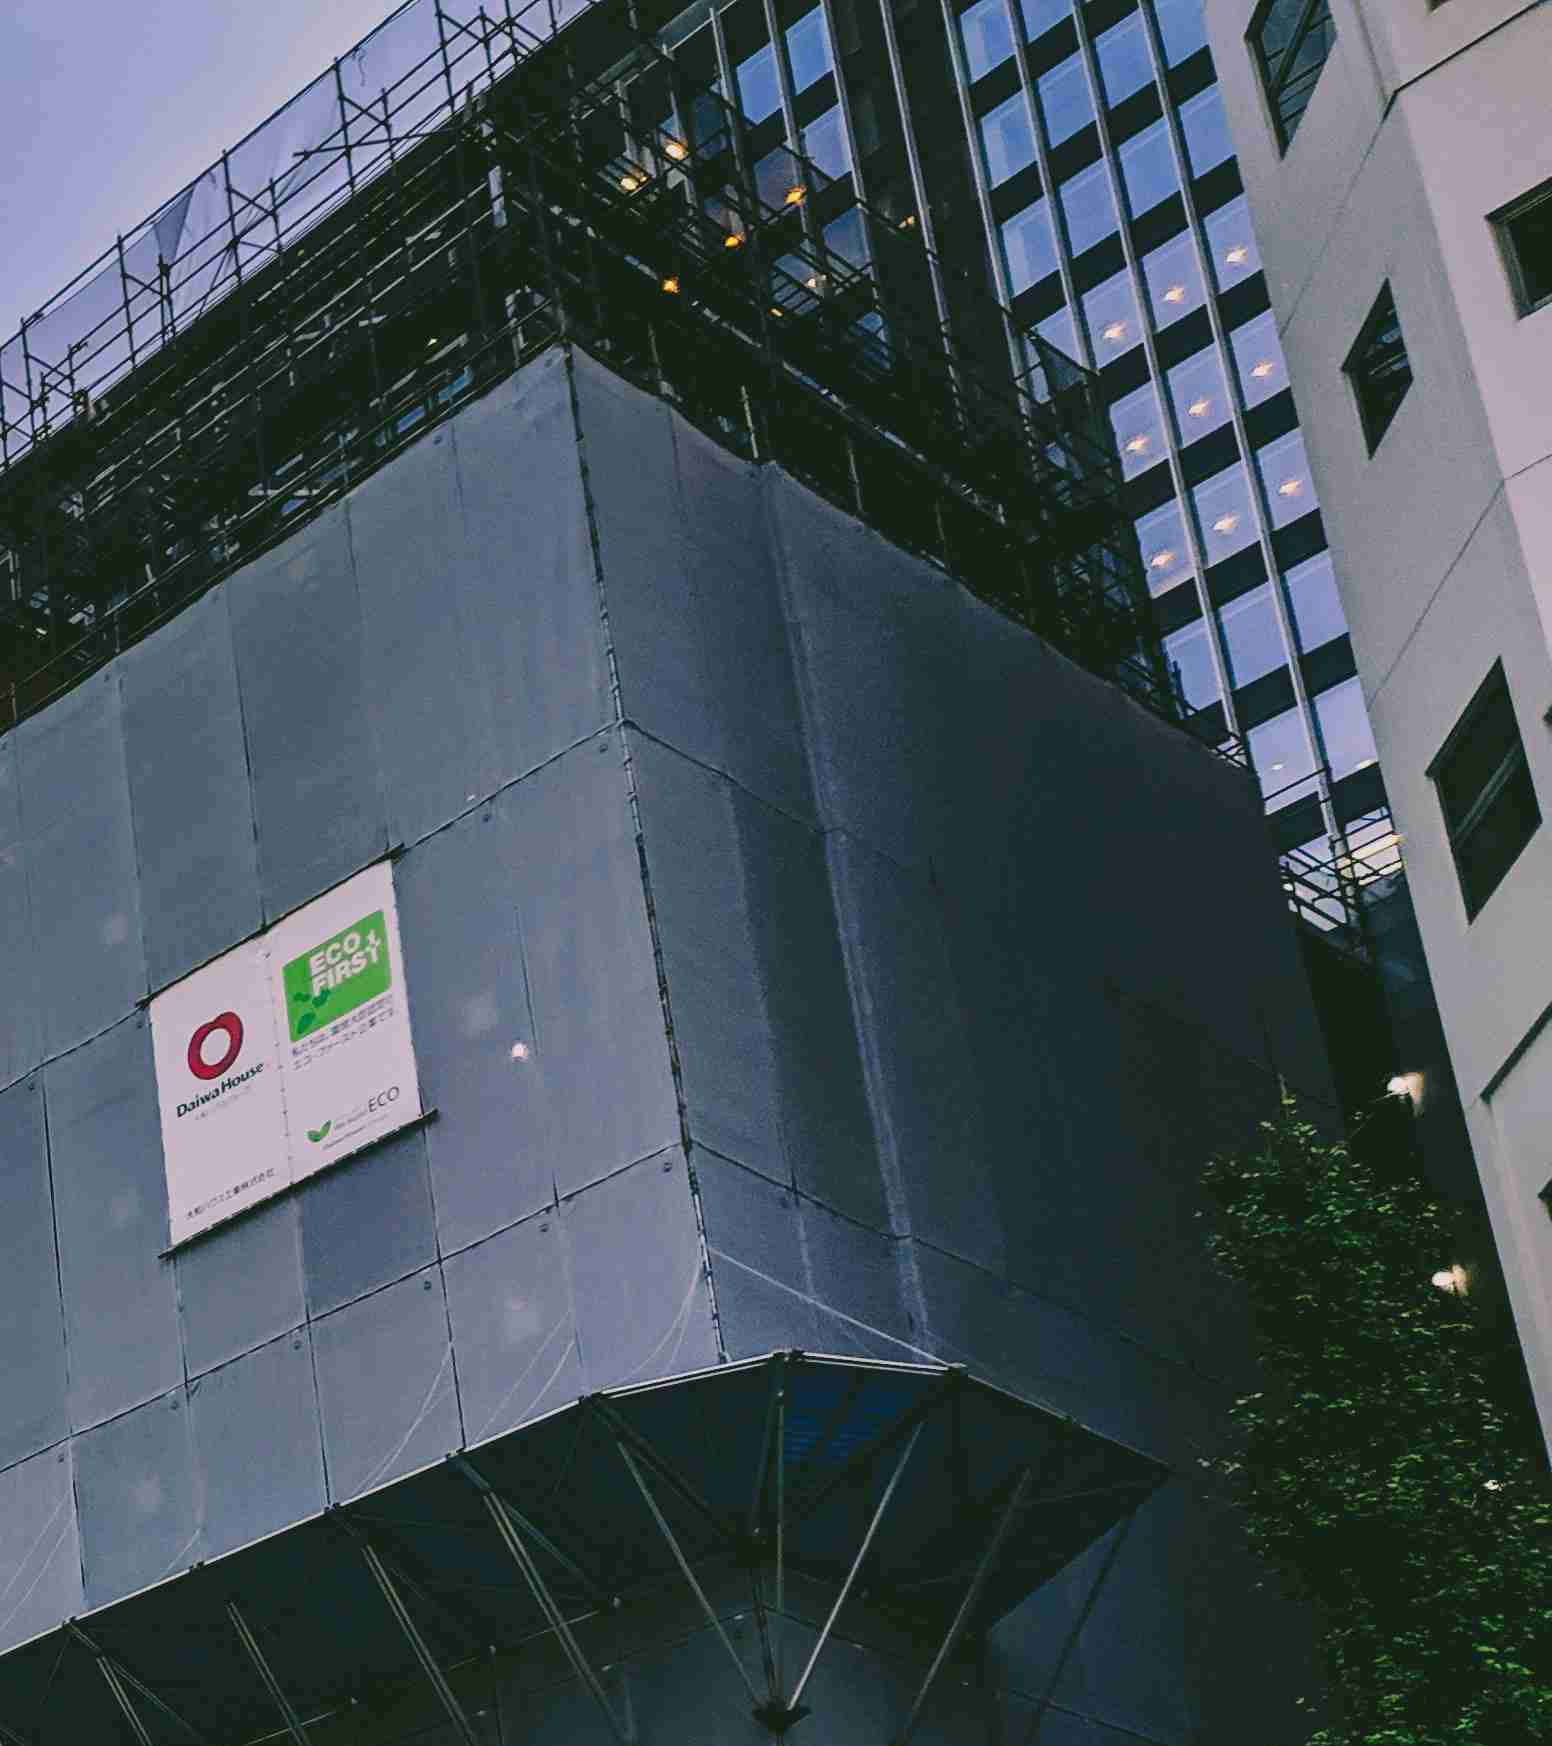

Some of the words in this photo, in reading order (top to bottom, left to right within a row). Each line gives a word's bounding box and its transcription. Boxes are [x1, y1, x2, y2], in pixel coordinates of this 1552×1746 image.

[308, 932, 361, 975] ECO
[311, 938, 381, 997] FIRST
[175, 1086, 220, 1119] Daiwa
[220, 1060, 265, 1096] House
[368, 1085, 401, 1113] ECO
